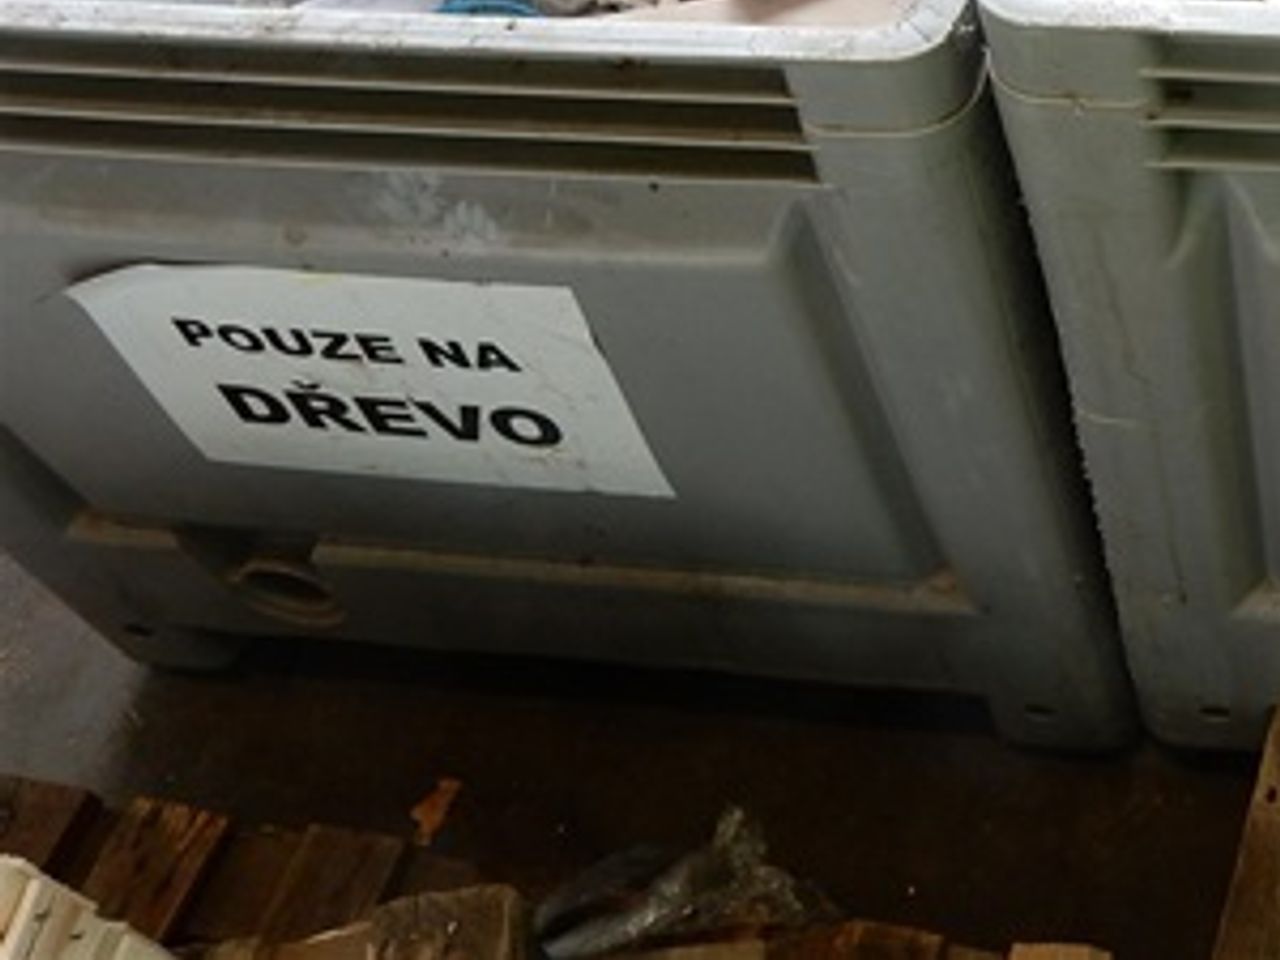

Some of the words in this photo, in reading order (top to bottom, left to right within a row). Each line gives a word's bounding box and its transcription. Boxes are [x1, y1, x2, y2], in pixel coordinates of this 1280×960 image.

[173, 318, 403, 364] POUZE
[419, 338, 521, 373] NA
[217, 380, 562, 447] DŘEVO
